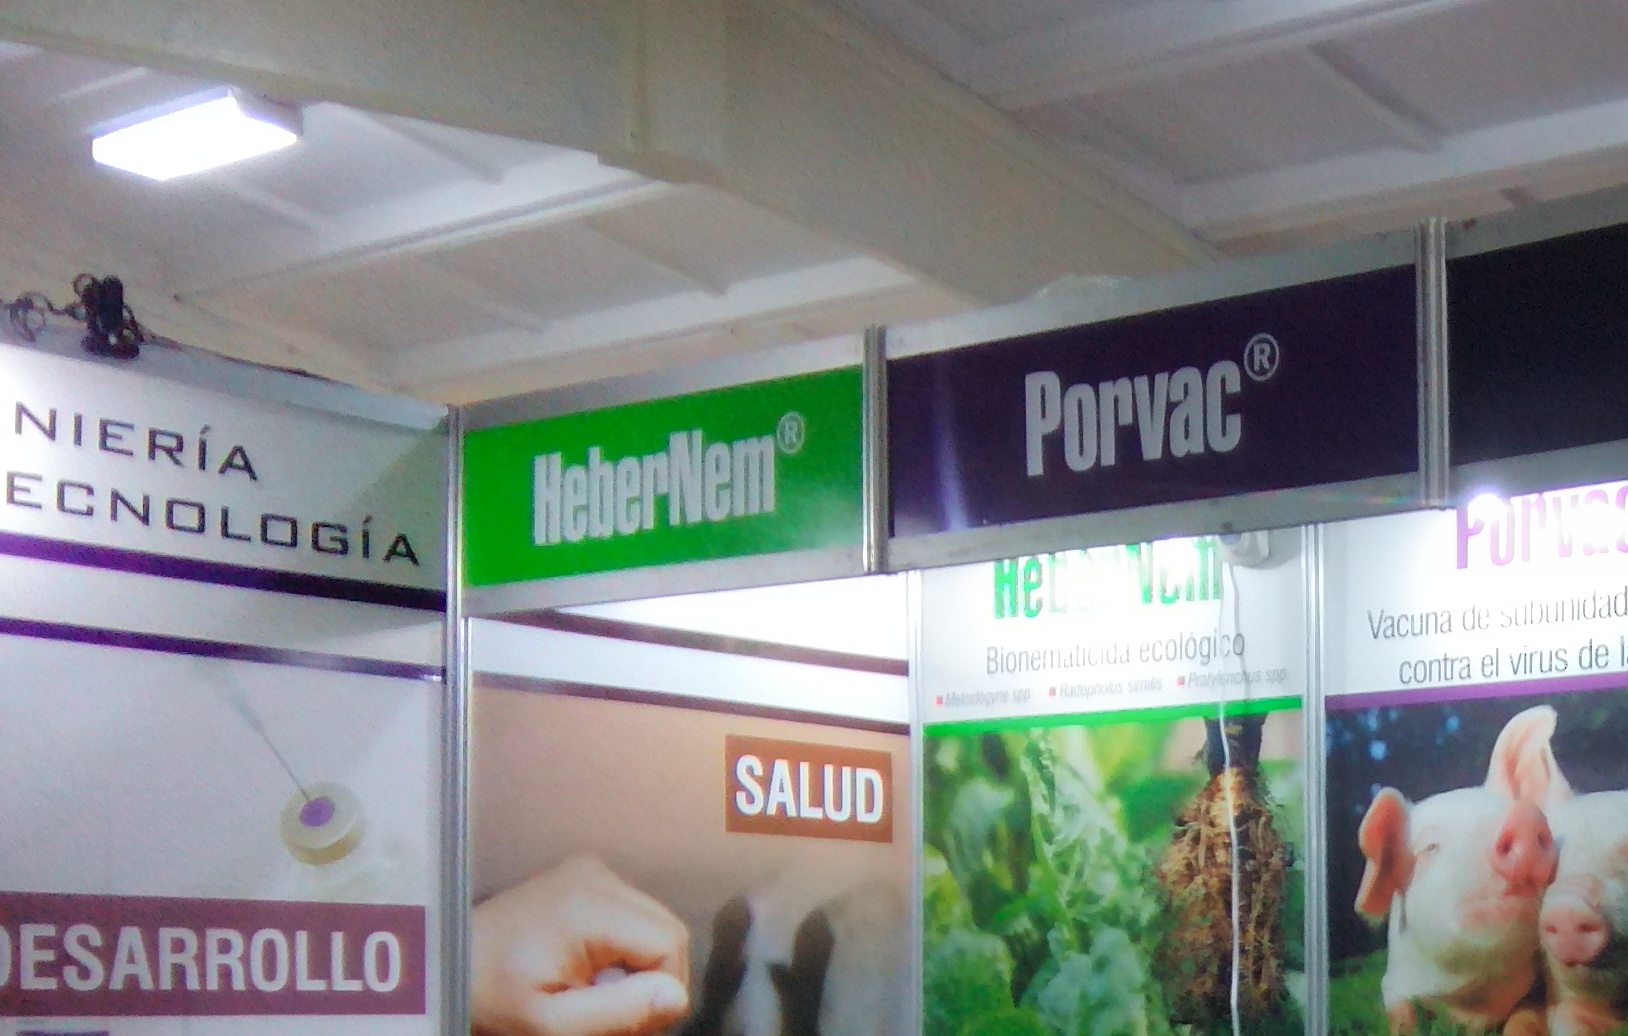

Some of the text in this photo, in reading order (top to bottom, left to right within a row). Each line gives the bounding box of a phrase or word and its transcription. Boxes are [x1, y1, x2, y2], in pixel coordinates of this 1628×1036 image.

[15, 400, 260, 482] NIERÍA
[7, 470, 420, 567] ECNOLOGÍA
[1368, 607, 1452, 641] Vacuna
[1462, 602, 1489, 631] de
[1501, 585, 1628, 630] subunidad
[986, 628, 1245, 675] Bionematicida ecológico
[1399, 650, 1471, 684] contra
[1481, 648, 1499, 678] el
[1509, 643, 1568, 675] virus
[1579, 638, 1609, 669] de
[735, 753, 885, 826] SALUD
